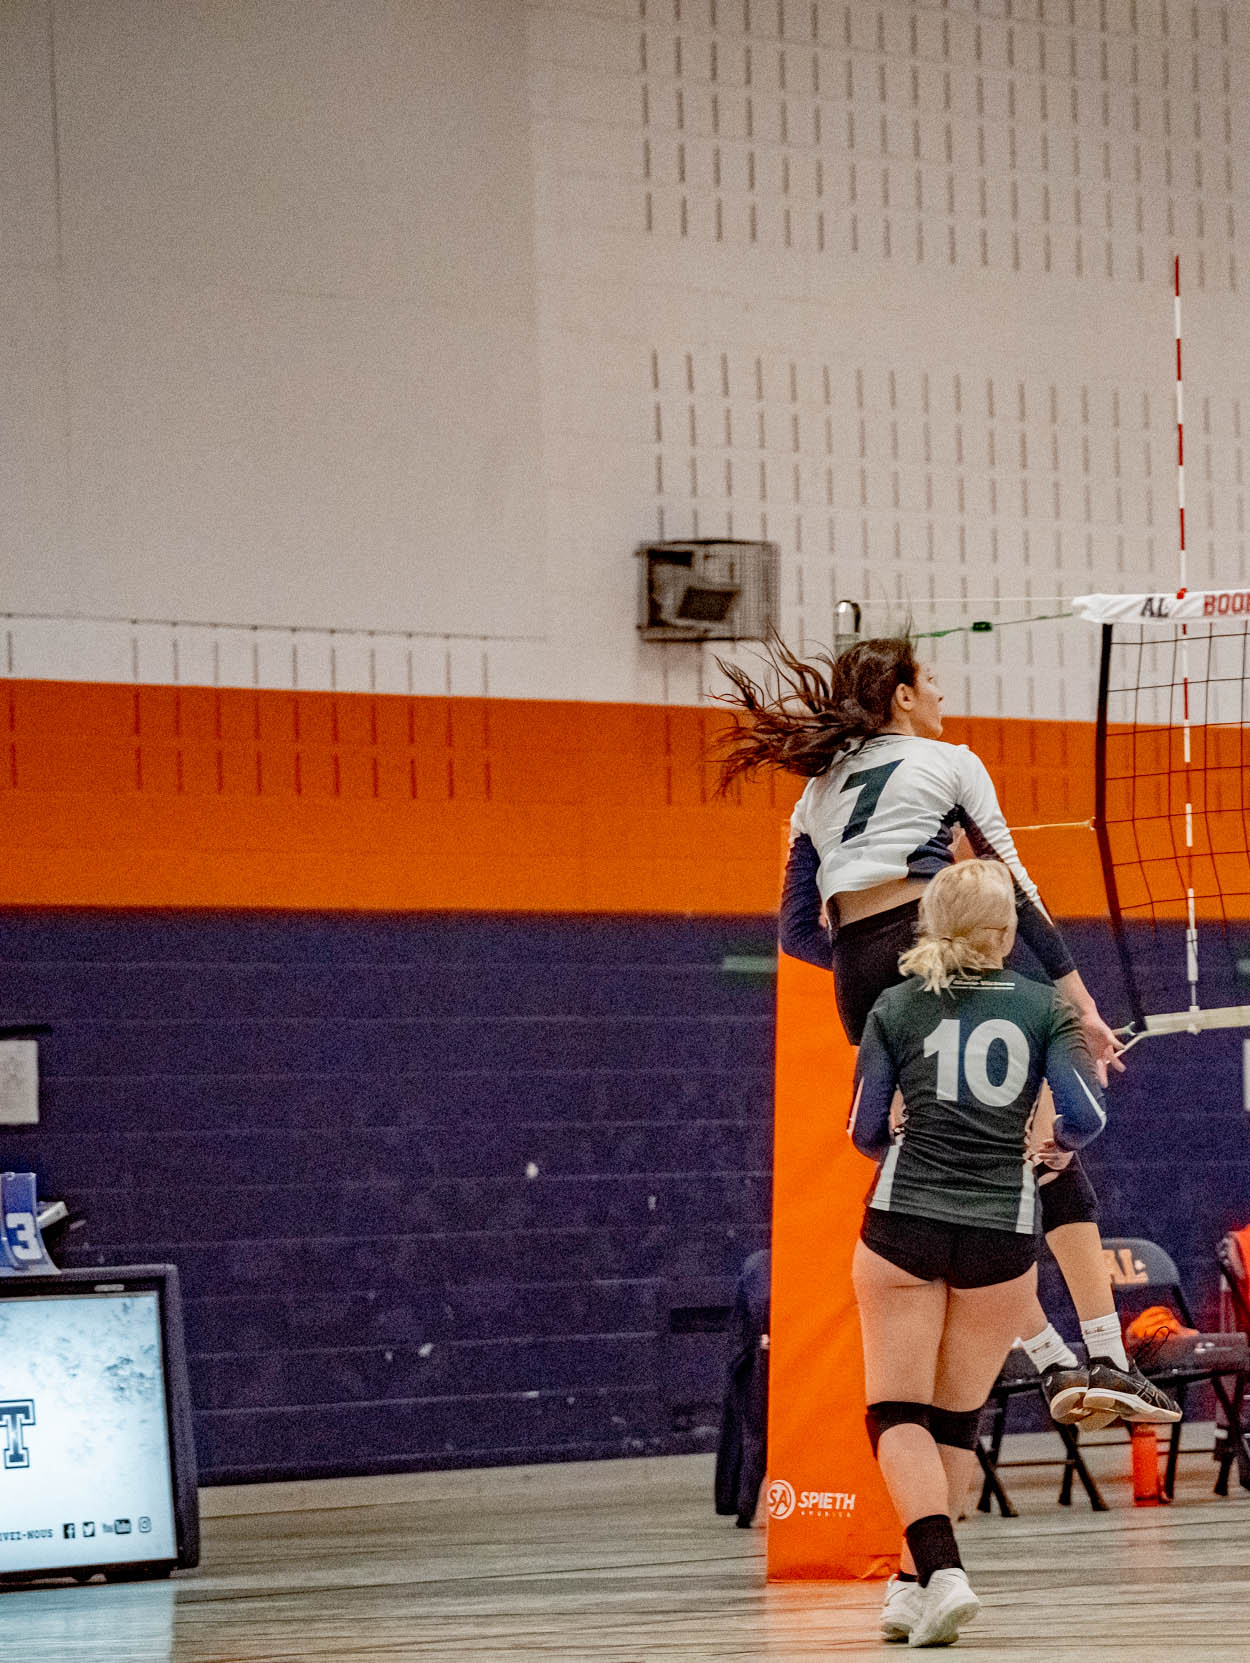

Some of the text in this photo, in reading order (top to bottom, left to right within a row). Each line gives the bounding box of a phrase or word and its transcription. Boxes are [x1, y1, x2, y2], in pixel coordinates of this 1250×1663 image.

[839, 758, 905, 844] 7
[922, 1018, 1031, 1107] 10
[6, 1211, 43, 1260] 3
[797, 1491, 856, 1510] SPIETH
[0, 1529, 53, 1541] VEZ-NOUS
